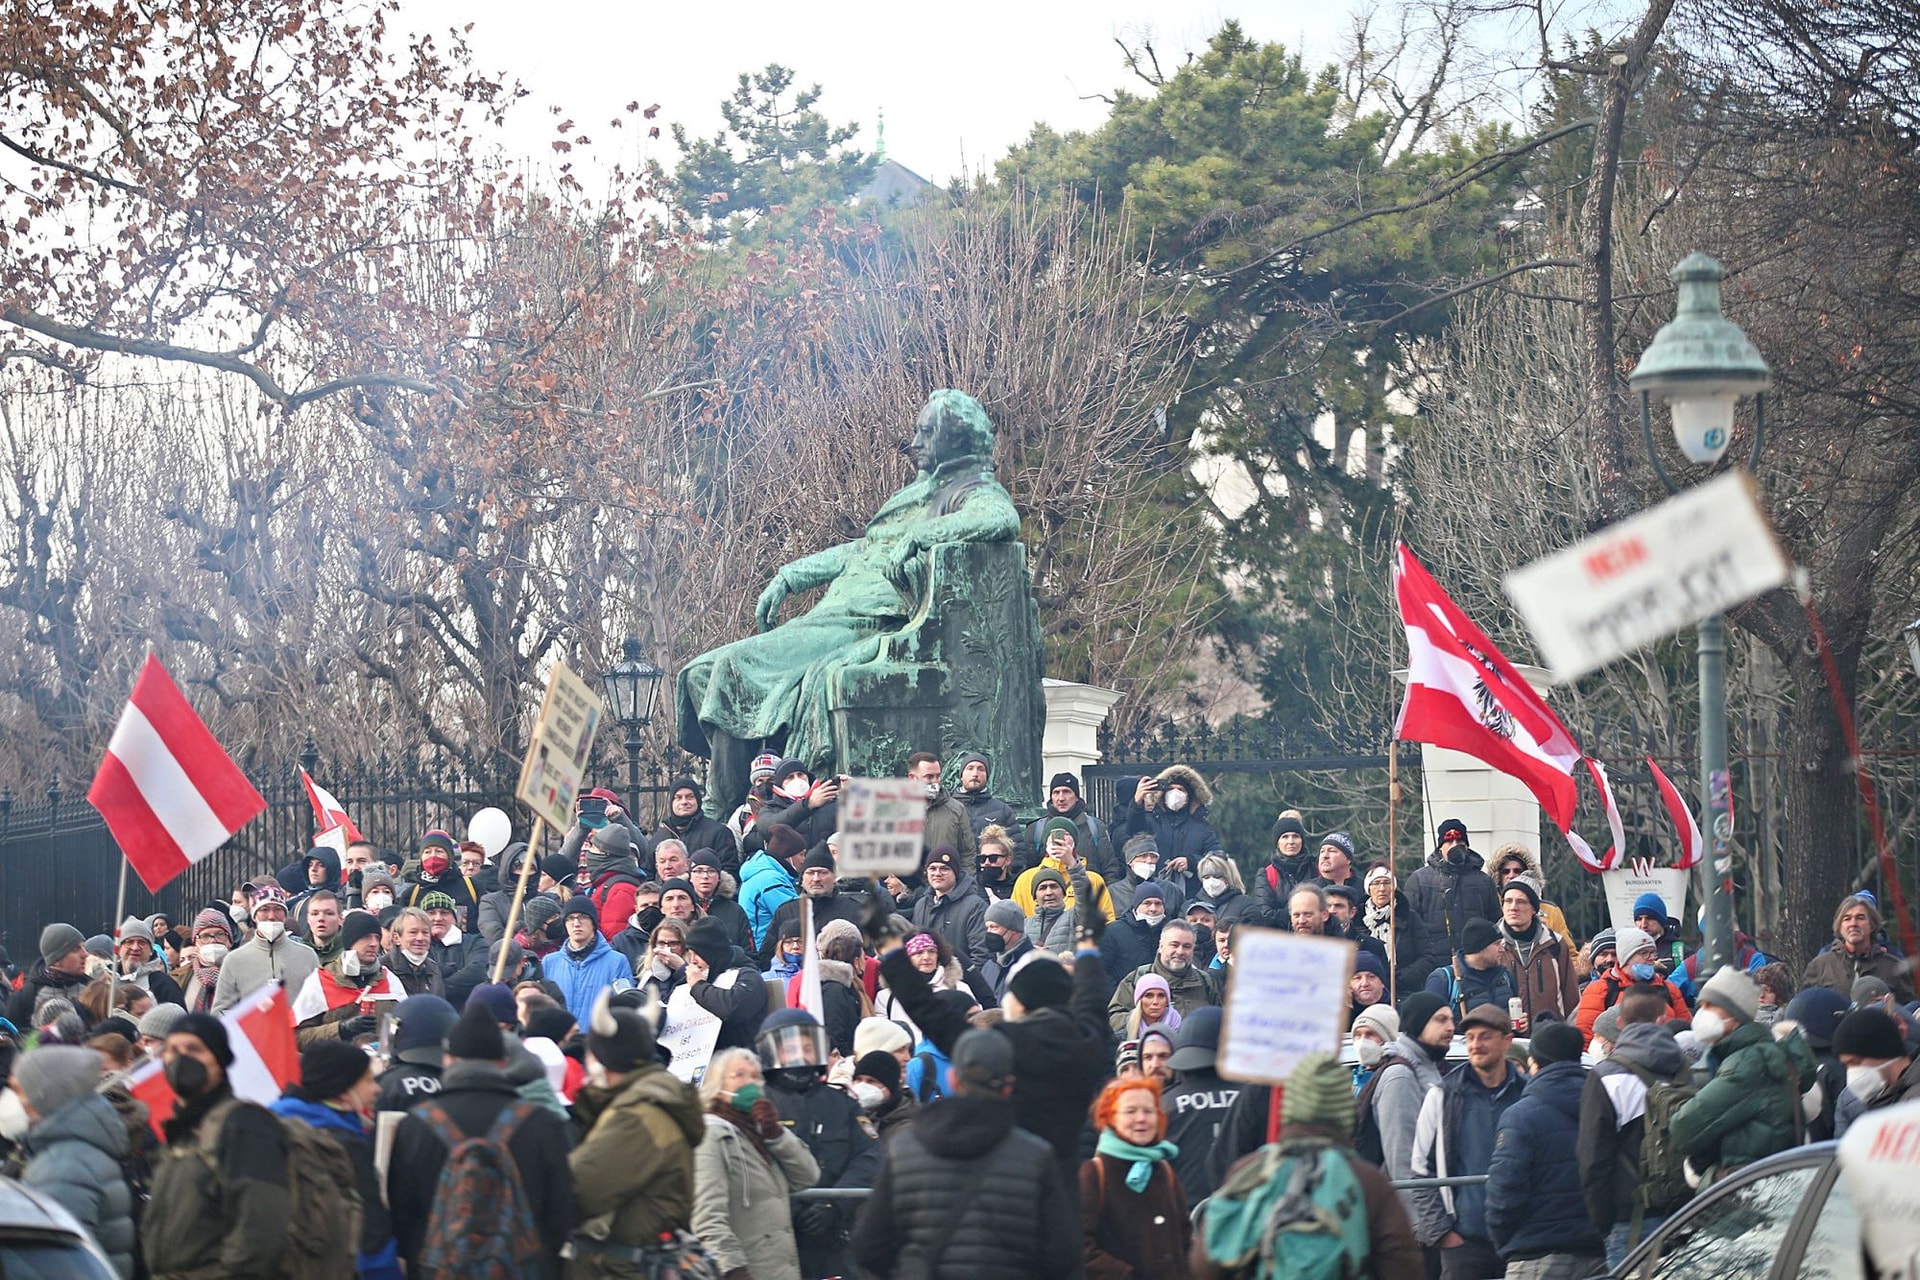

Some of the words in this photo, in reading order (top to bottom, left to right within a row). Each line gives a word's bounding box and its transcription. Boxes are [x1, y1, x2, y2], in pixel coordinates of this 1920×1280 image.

[1631, 856, 1656, 877] W
[680, 1034, 692, 1046] ist
[674, 1047, 702, 1062] istisch
[1175, 1090, 1240, 1113] POLIZ
